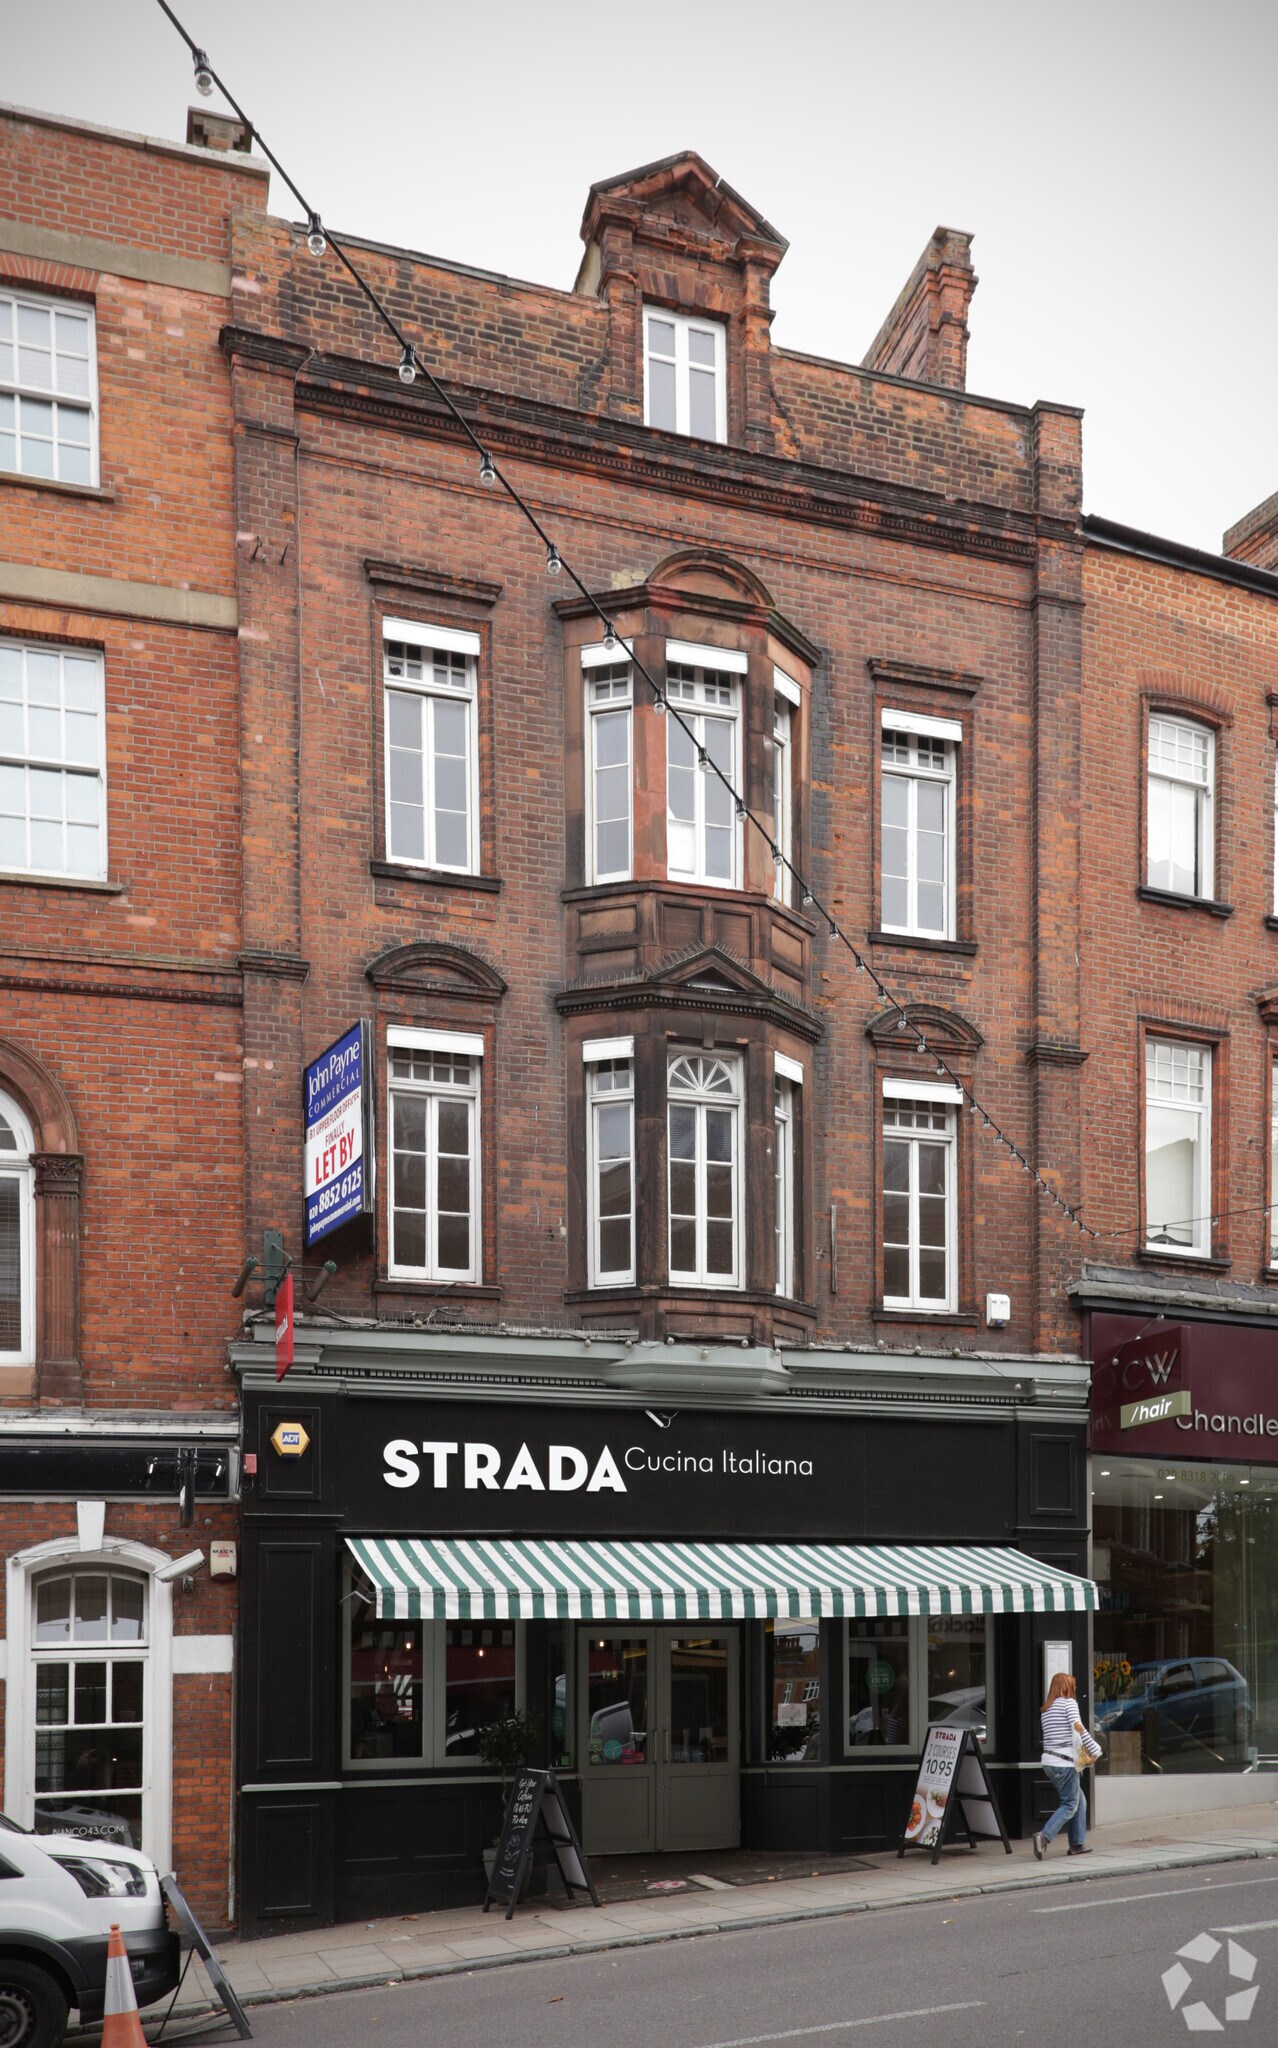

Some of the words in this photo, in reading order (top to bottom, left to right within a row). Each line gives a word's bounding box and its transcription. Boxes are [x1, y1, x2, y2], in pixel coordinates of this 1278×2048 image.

[308, 1066, 329, 1107] John
[329, 1041, 360, 1080] Payne
[308, 1067, 360, 1118] COMMERCIAL
[315, 1144, 337, 1186] LET
[339, 1127, 355, 1169] BY
[325, 1120, 345, 1147] FINALLY
[308, 1204, 319, 1221] 020
[319, 1182, 341, 1214] 8852
[341, 1166, 362, 1199] 6125
[282, 1434, 300, 1443] ADT
[382, 1438, 628, 1493] STRADA
[624, 1446, 714, 1473] Cucina
[722, 1449, 814, 1476] Italiana
[935, 1731, 957, 1742] STRADA
